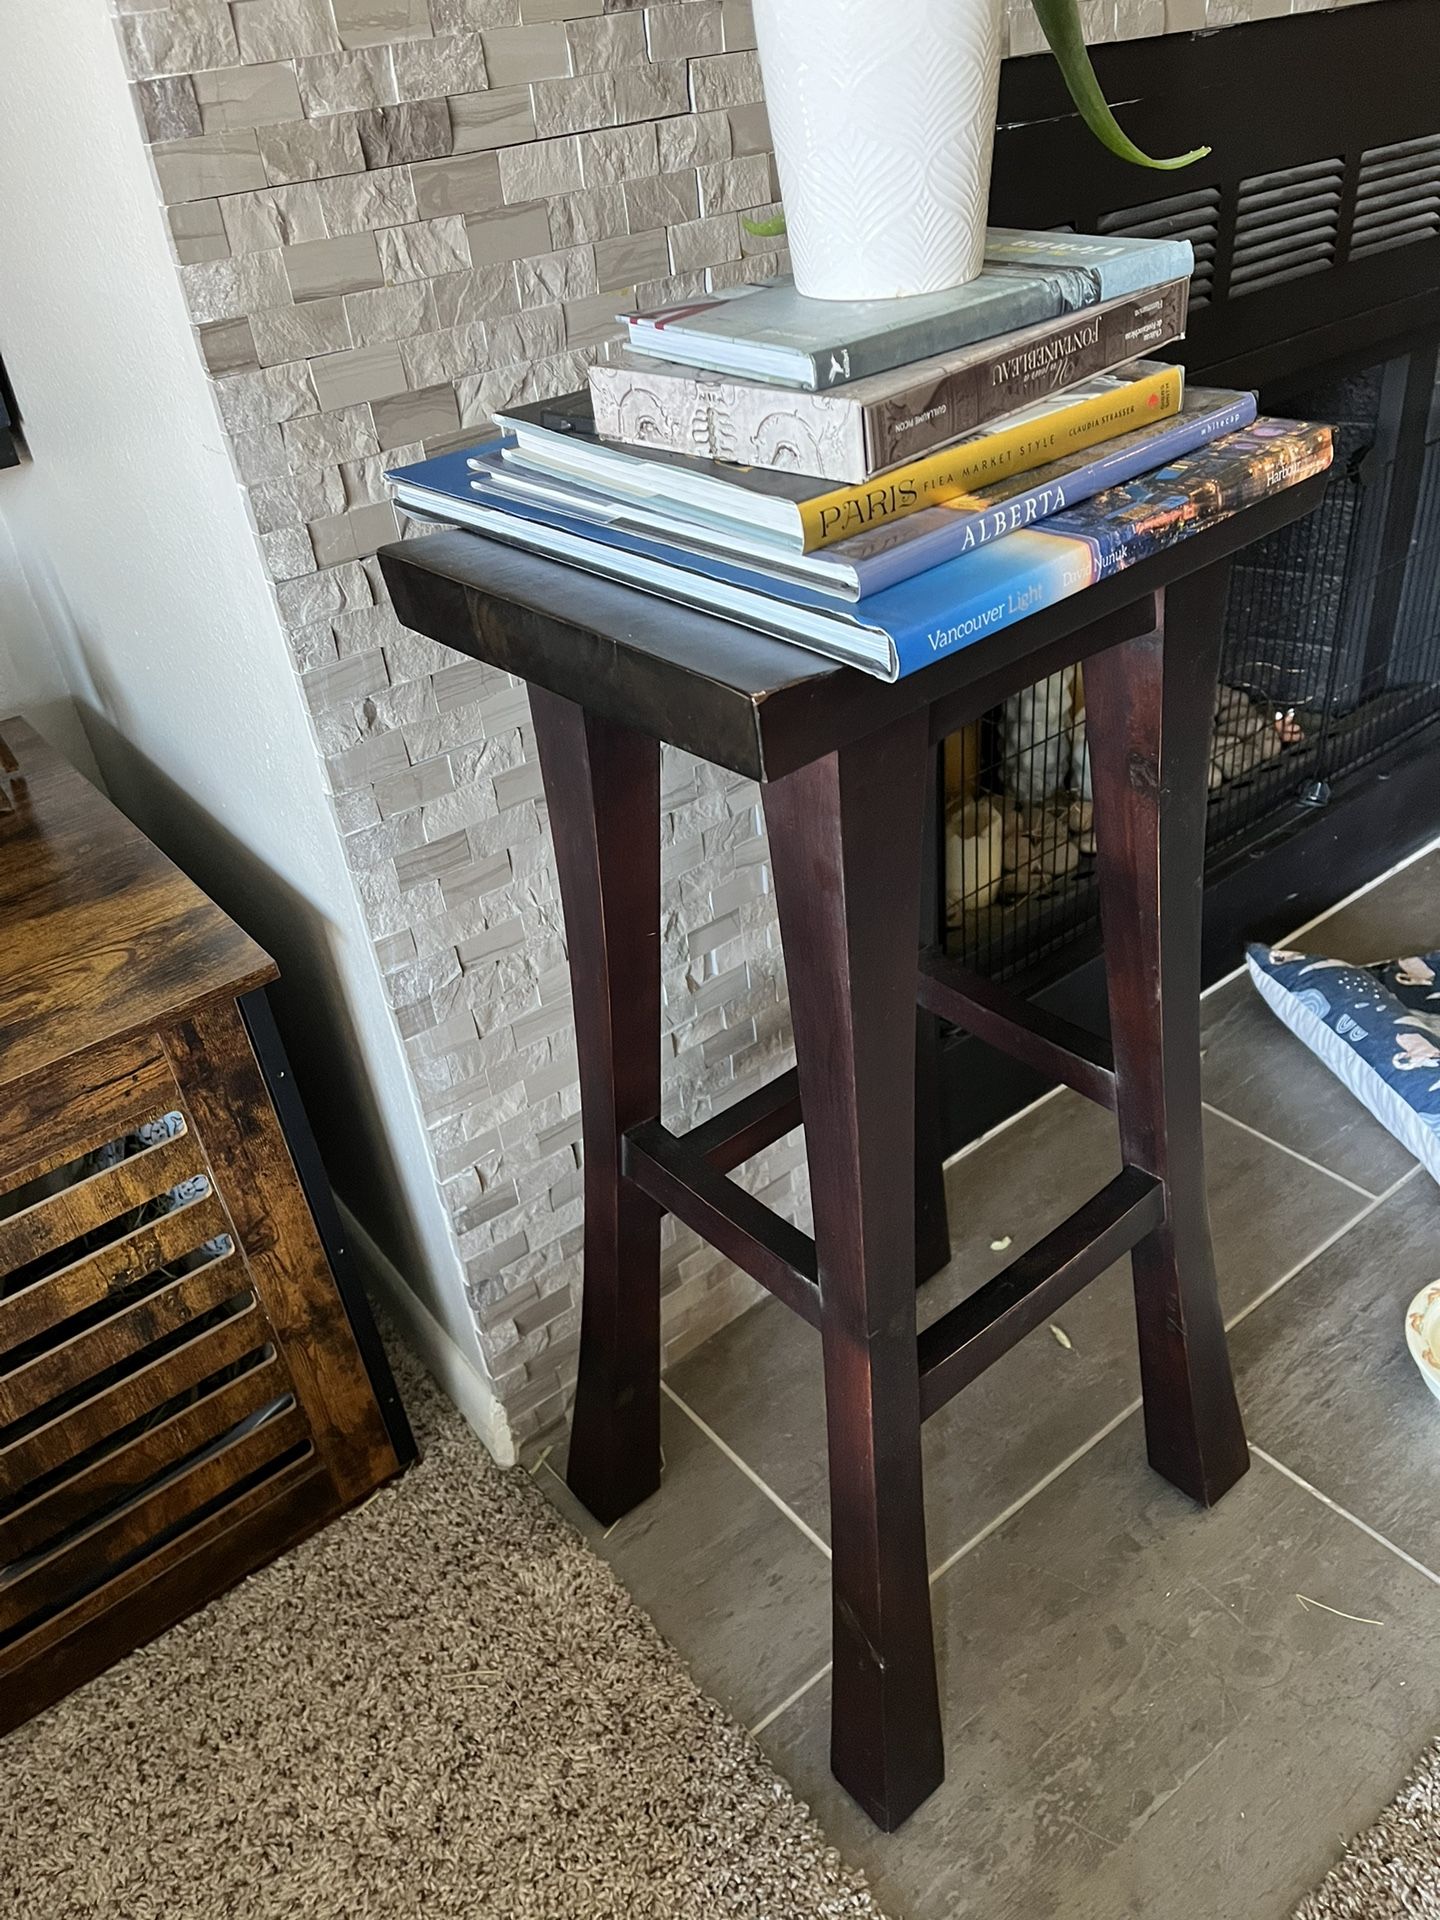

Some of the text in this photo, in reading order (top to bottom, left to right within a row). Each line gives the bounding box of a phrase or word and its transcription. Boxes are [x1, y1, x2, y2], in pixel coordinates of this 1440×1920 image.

[992, 315, 1102, 386] FONTAINEBLEAU
[895, 404, 947, 433] GUILLAUME PICON
[1068, 405, 1136, 437] CLAUDIA STRASSER
[1201, 413, 1240, 436] whitecap
[819, 433, 1056, 538] PARIS FLEA MARKET STYLE
[1266, 461, 1302, 487] Harbour
[961, 485, 1066, 551] ALBERTA
[1063, 544, 1128, 588] David Nunuk
[928, 583, 1044, 652] Vancouver Light
